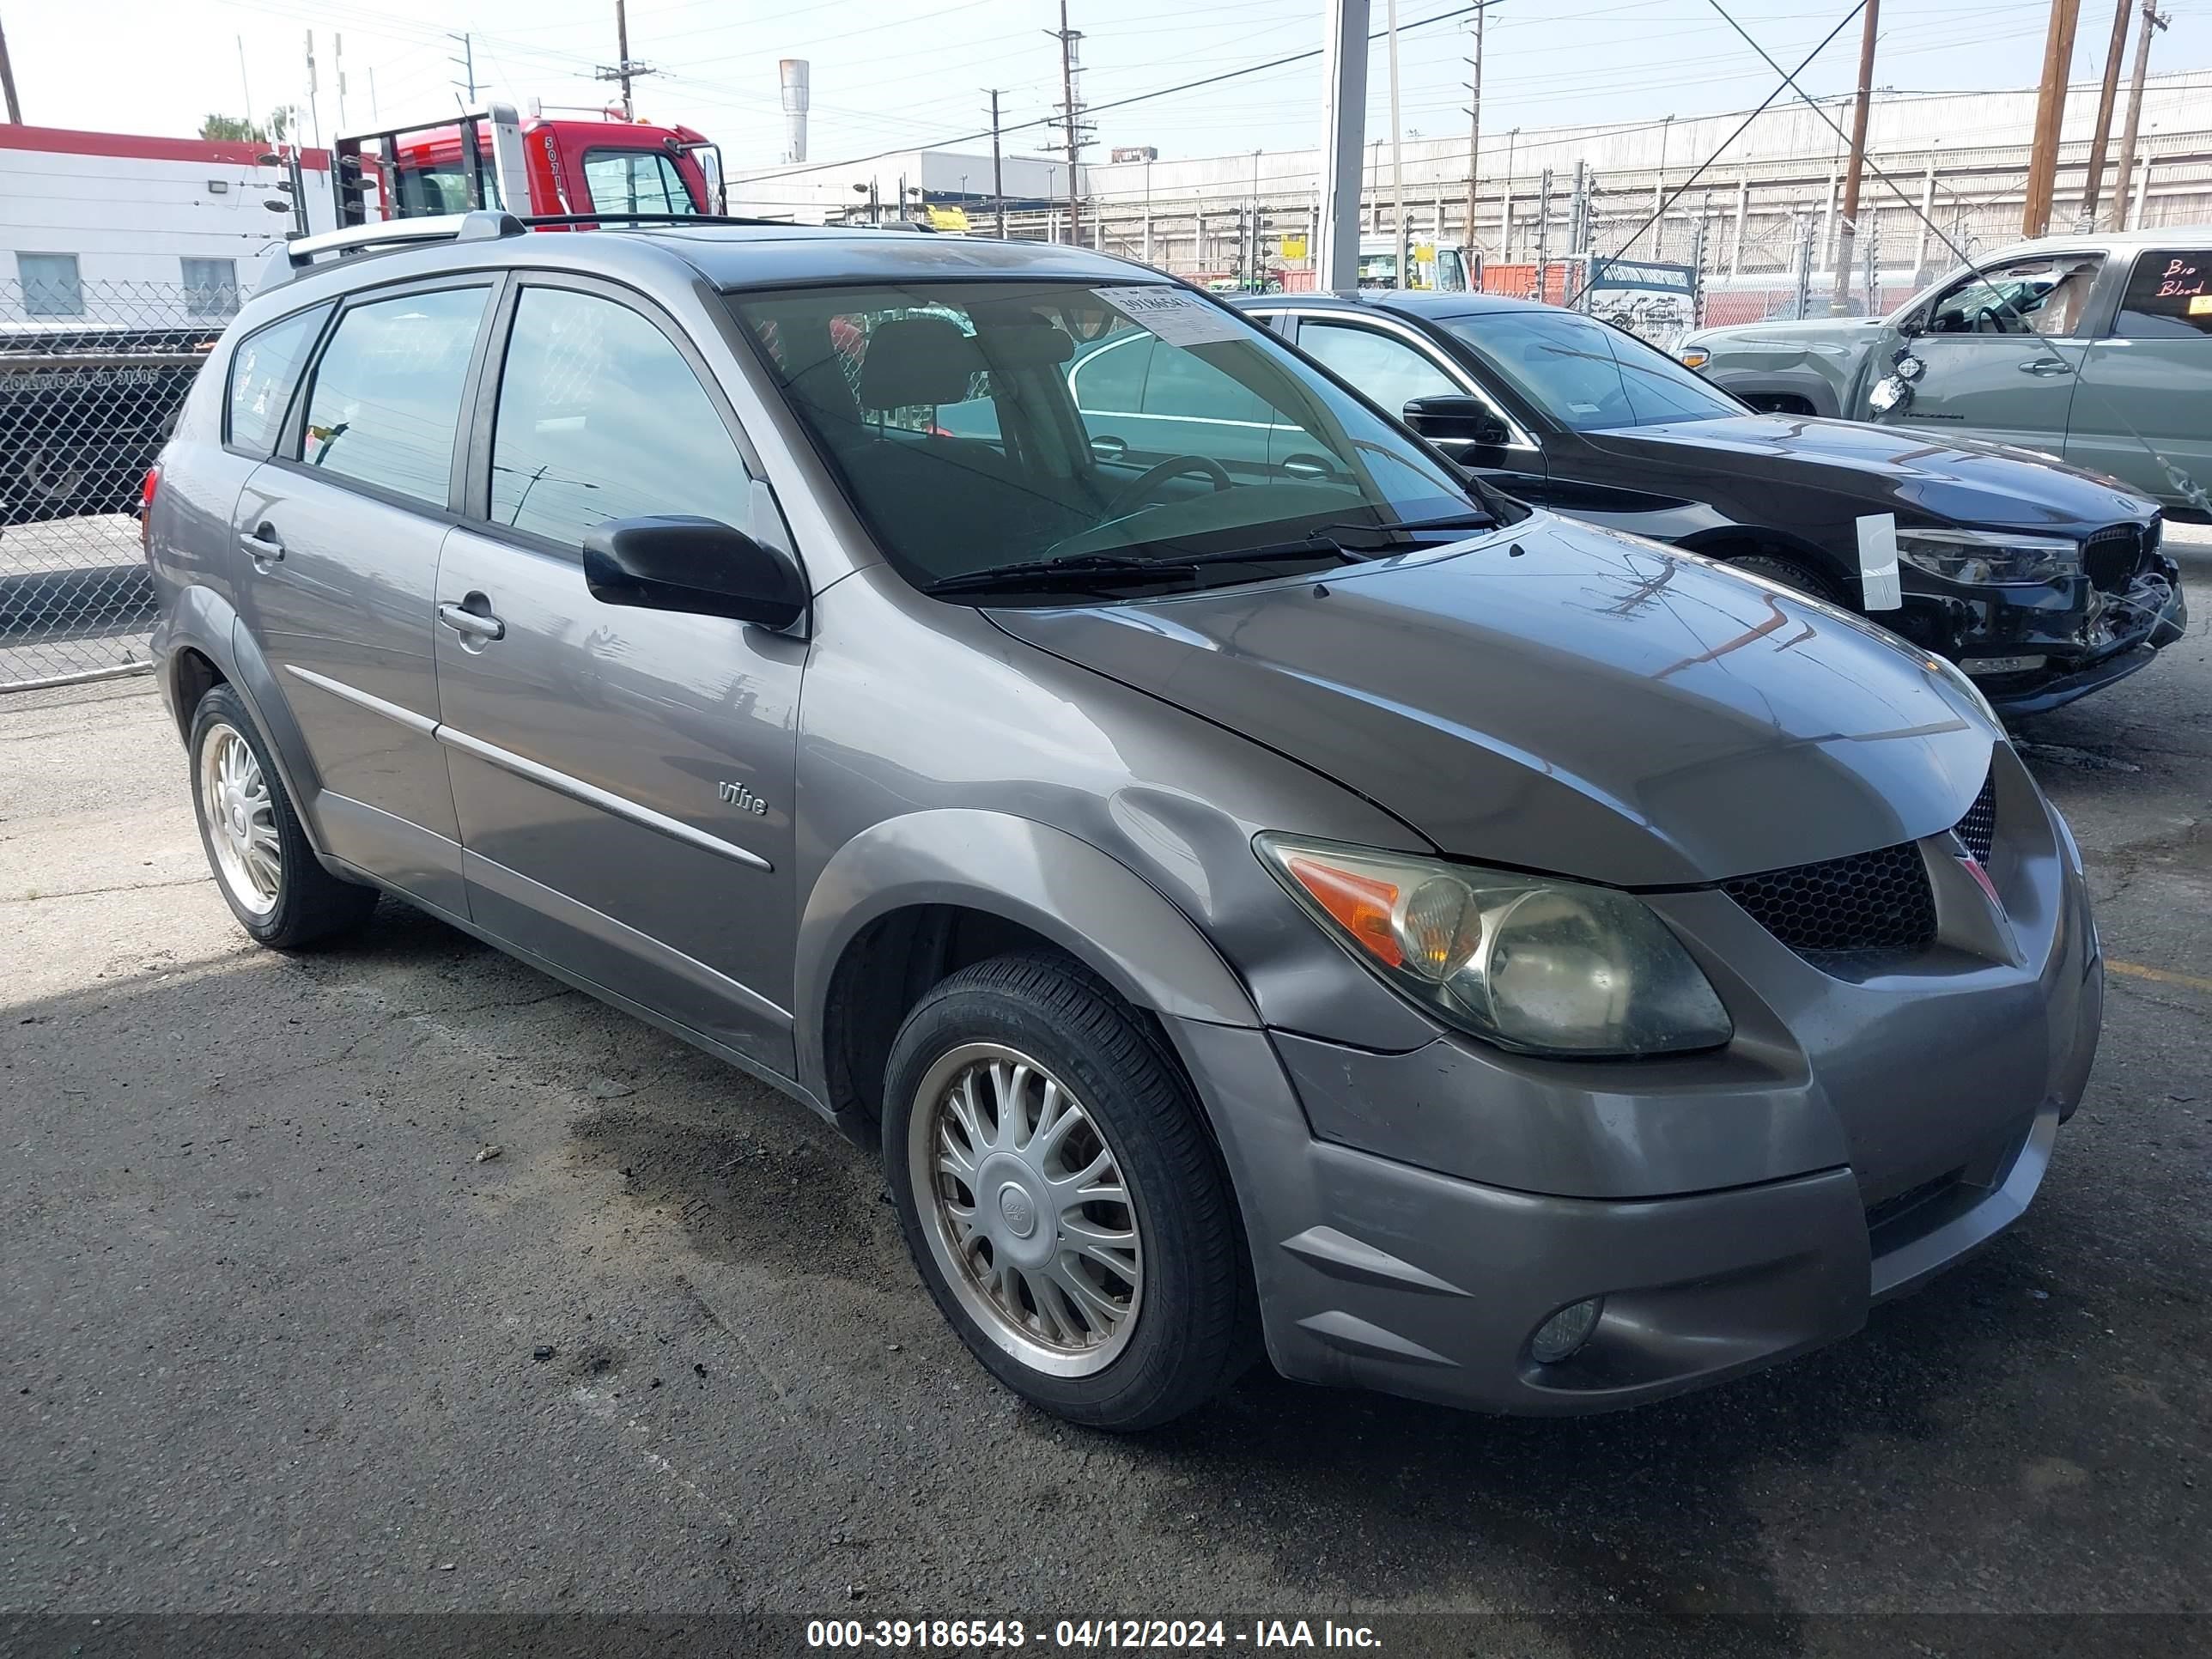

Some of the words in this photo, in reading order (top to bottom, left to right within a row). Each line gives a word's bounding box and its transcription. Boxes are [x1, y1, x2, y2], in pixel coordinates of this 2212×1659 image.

[544, 137, 562, 188] 5071
[2155, 280, 2204, 296] Blood
[1119, 297, 1191, 310] 39186543
[117, 368, 159, 385] 91605
